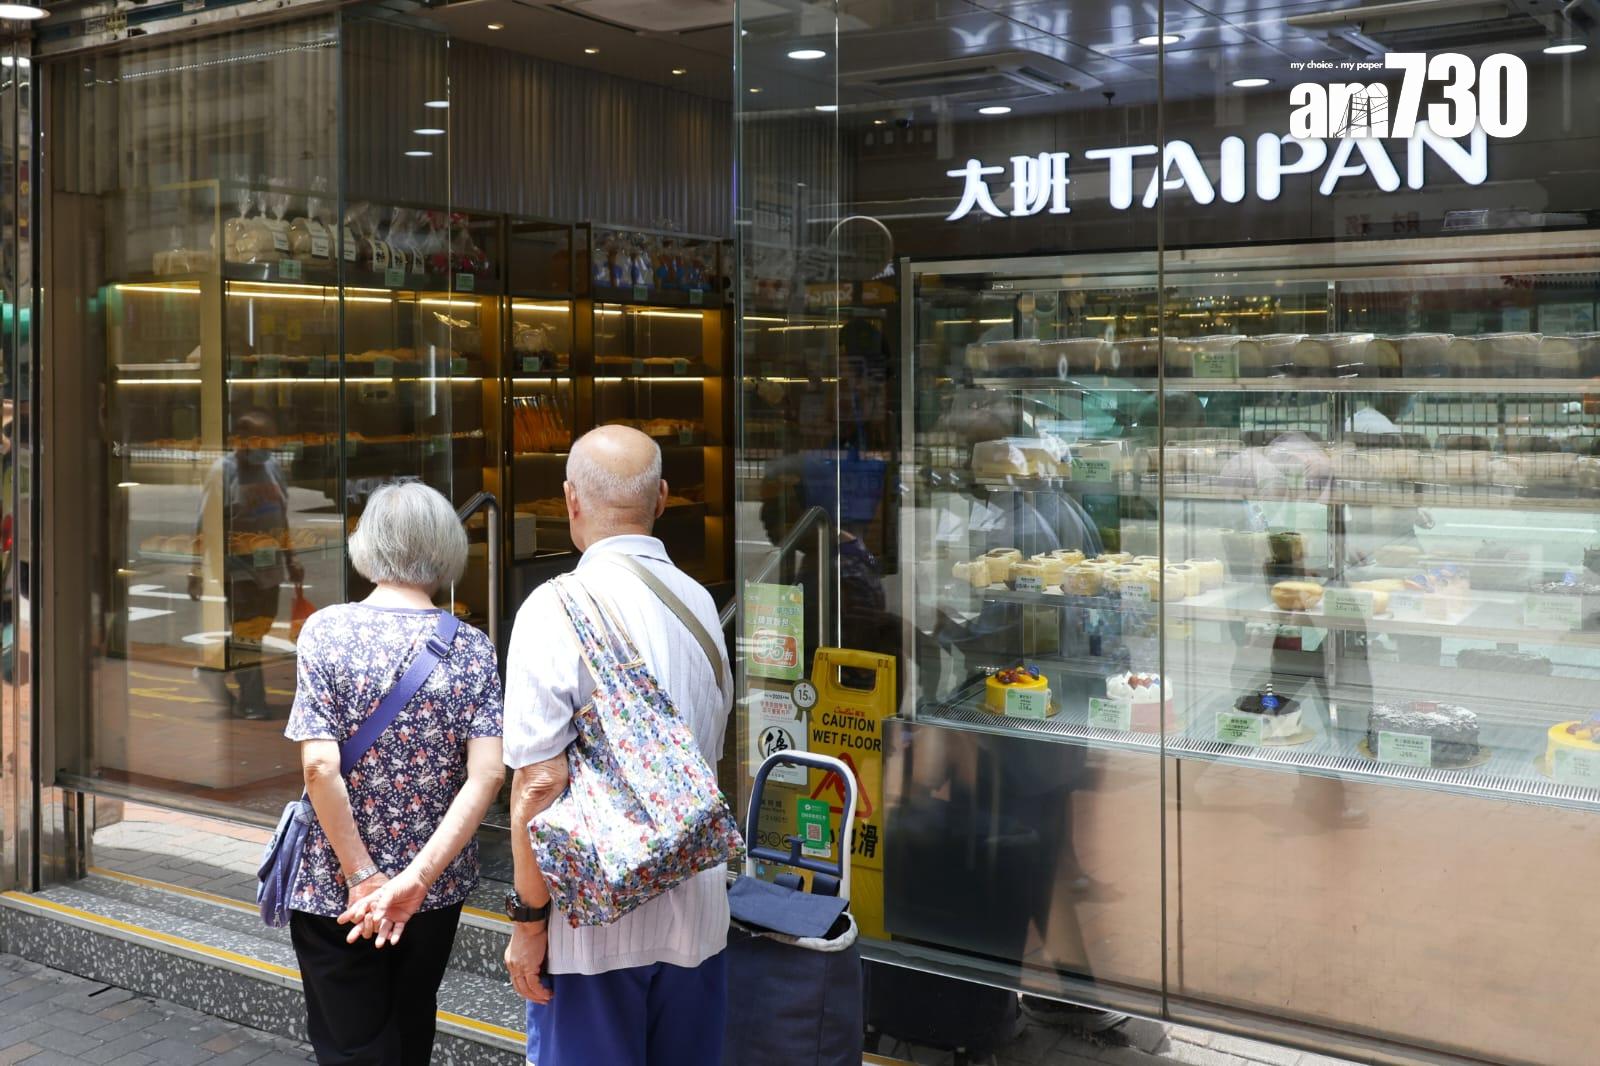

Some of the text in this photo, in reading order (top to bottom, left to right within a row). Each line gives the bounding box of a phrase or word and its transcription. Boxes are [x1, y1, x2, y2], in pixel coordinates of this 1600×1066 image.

[945, 151, 1071, 221] 大班
[1085, 117, 1488, 210] TAIPAN
[813, 729, 881, 752] WET FLOOR
[822, 712, 875, 732] CAUTION
